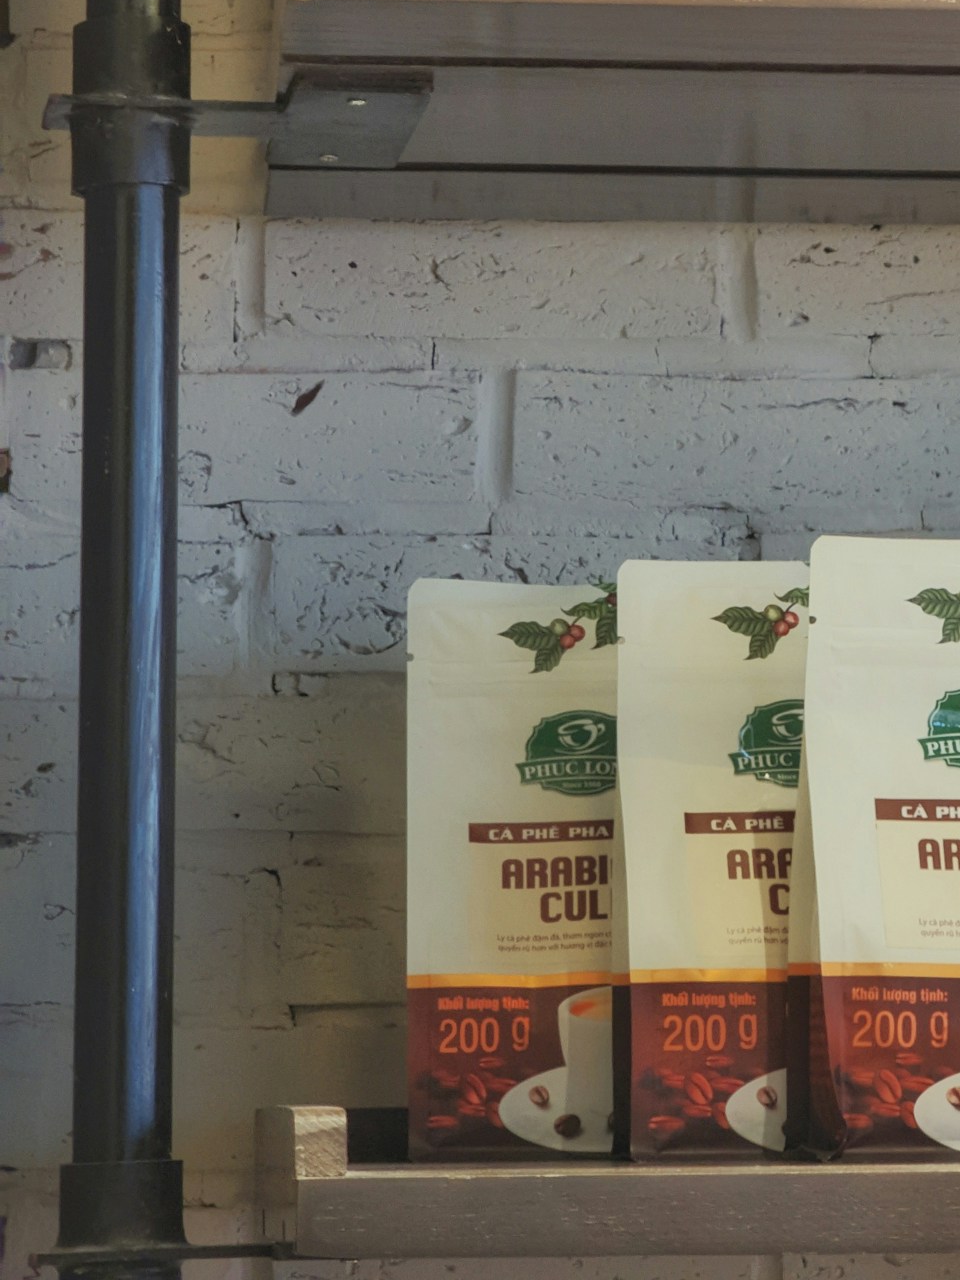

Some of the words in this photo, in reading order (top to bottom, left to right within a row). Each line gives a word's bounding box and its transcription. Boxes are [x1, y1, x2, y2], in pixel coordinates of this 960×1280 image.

[524, 761, 579, 780] PHUC
[584, 761, 618, 776] LON
[737, 752, 793, 770] PHUC
[710, 817, 737, 831] CÀ
[744, 816, 785, 830] PHÊ
[901, 803, 928, 819] CÀ
[522, 824, 559, 840] PHÊ
[568, 825, 610, 838] PHA
[502, 855, 611, 890] ARABI
[540, 890, 611, 924] CUL
[439, 1018, 500, 1053] 200
[511, 1016, 529, 1052] g
[663, 1014, 727, 1051] 200
[739, 1014, 757, 1050] g
[852, 1010, 917, 1048] 200
[930, 1011, 948, 1048] g
